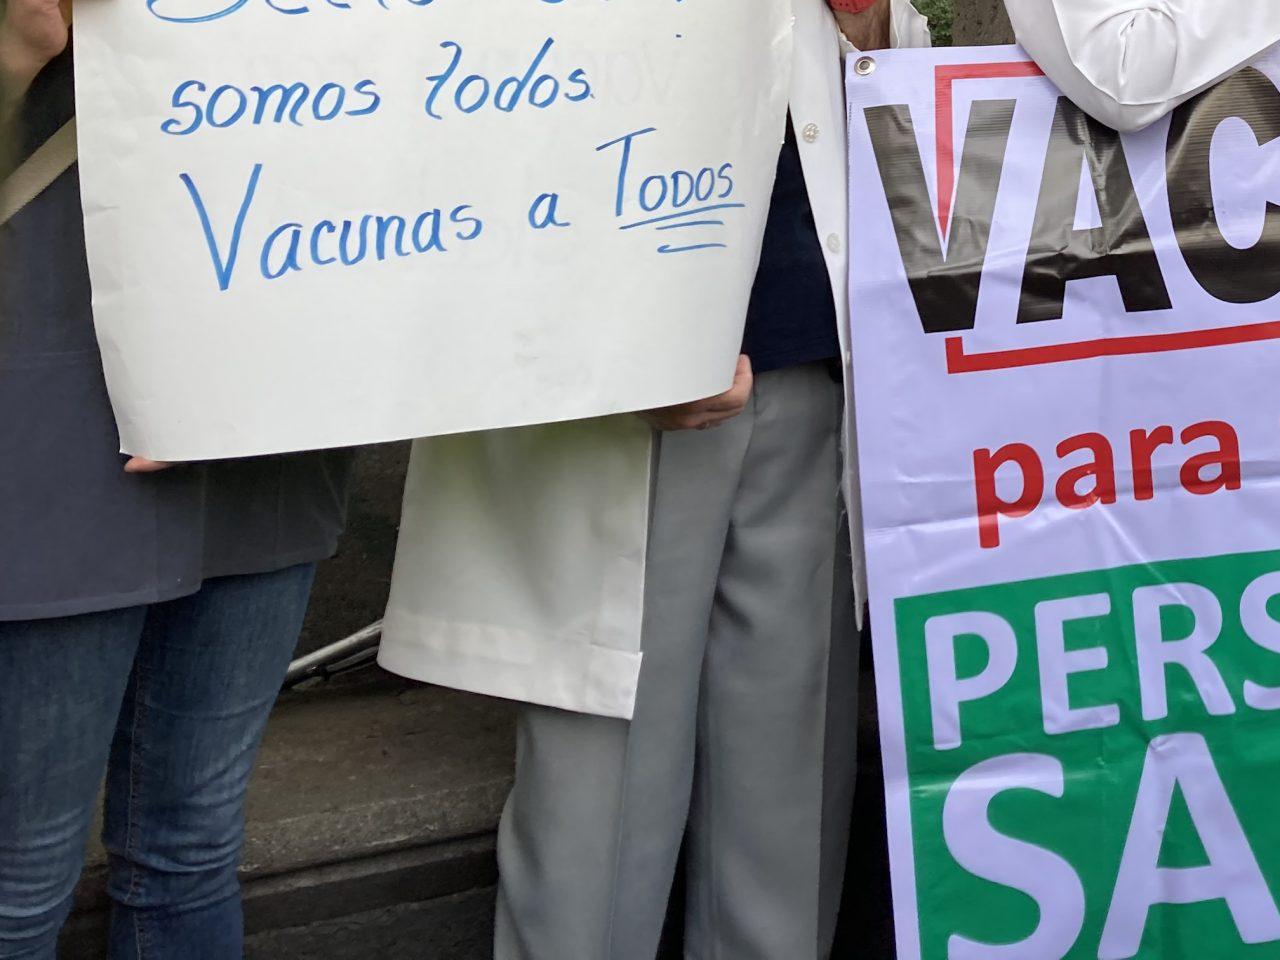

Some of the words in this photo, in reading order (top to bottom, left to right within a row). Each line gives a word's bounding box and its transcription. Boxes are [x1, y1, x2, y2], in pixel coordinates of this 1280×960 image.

[161, 77, 381, 135] somos
[179, 163, 484, 291] Vacunas
[528, 192, 570, 228] a
[973, 419, 1242, 549] para
